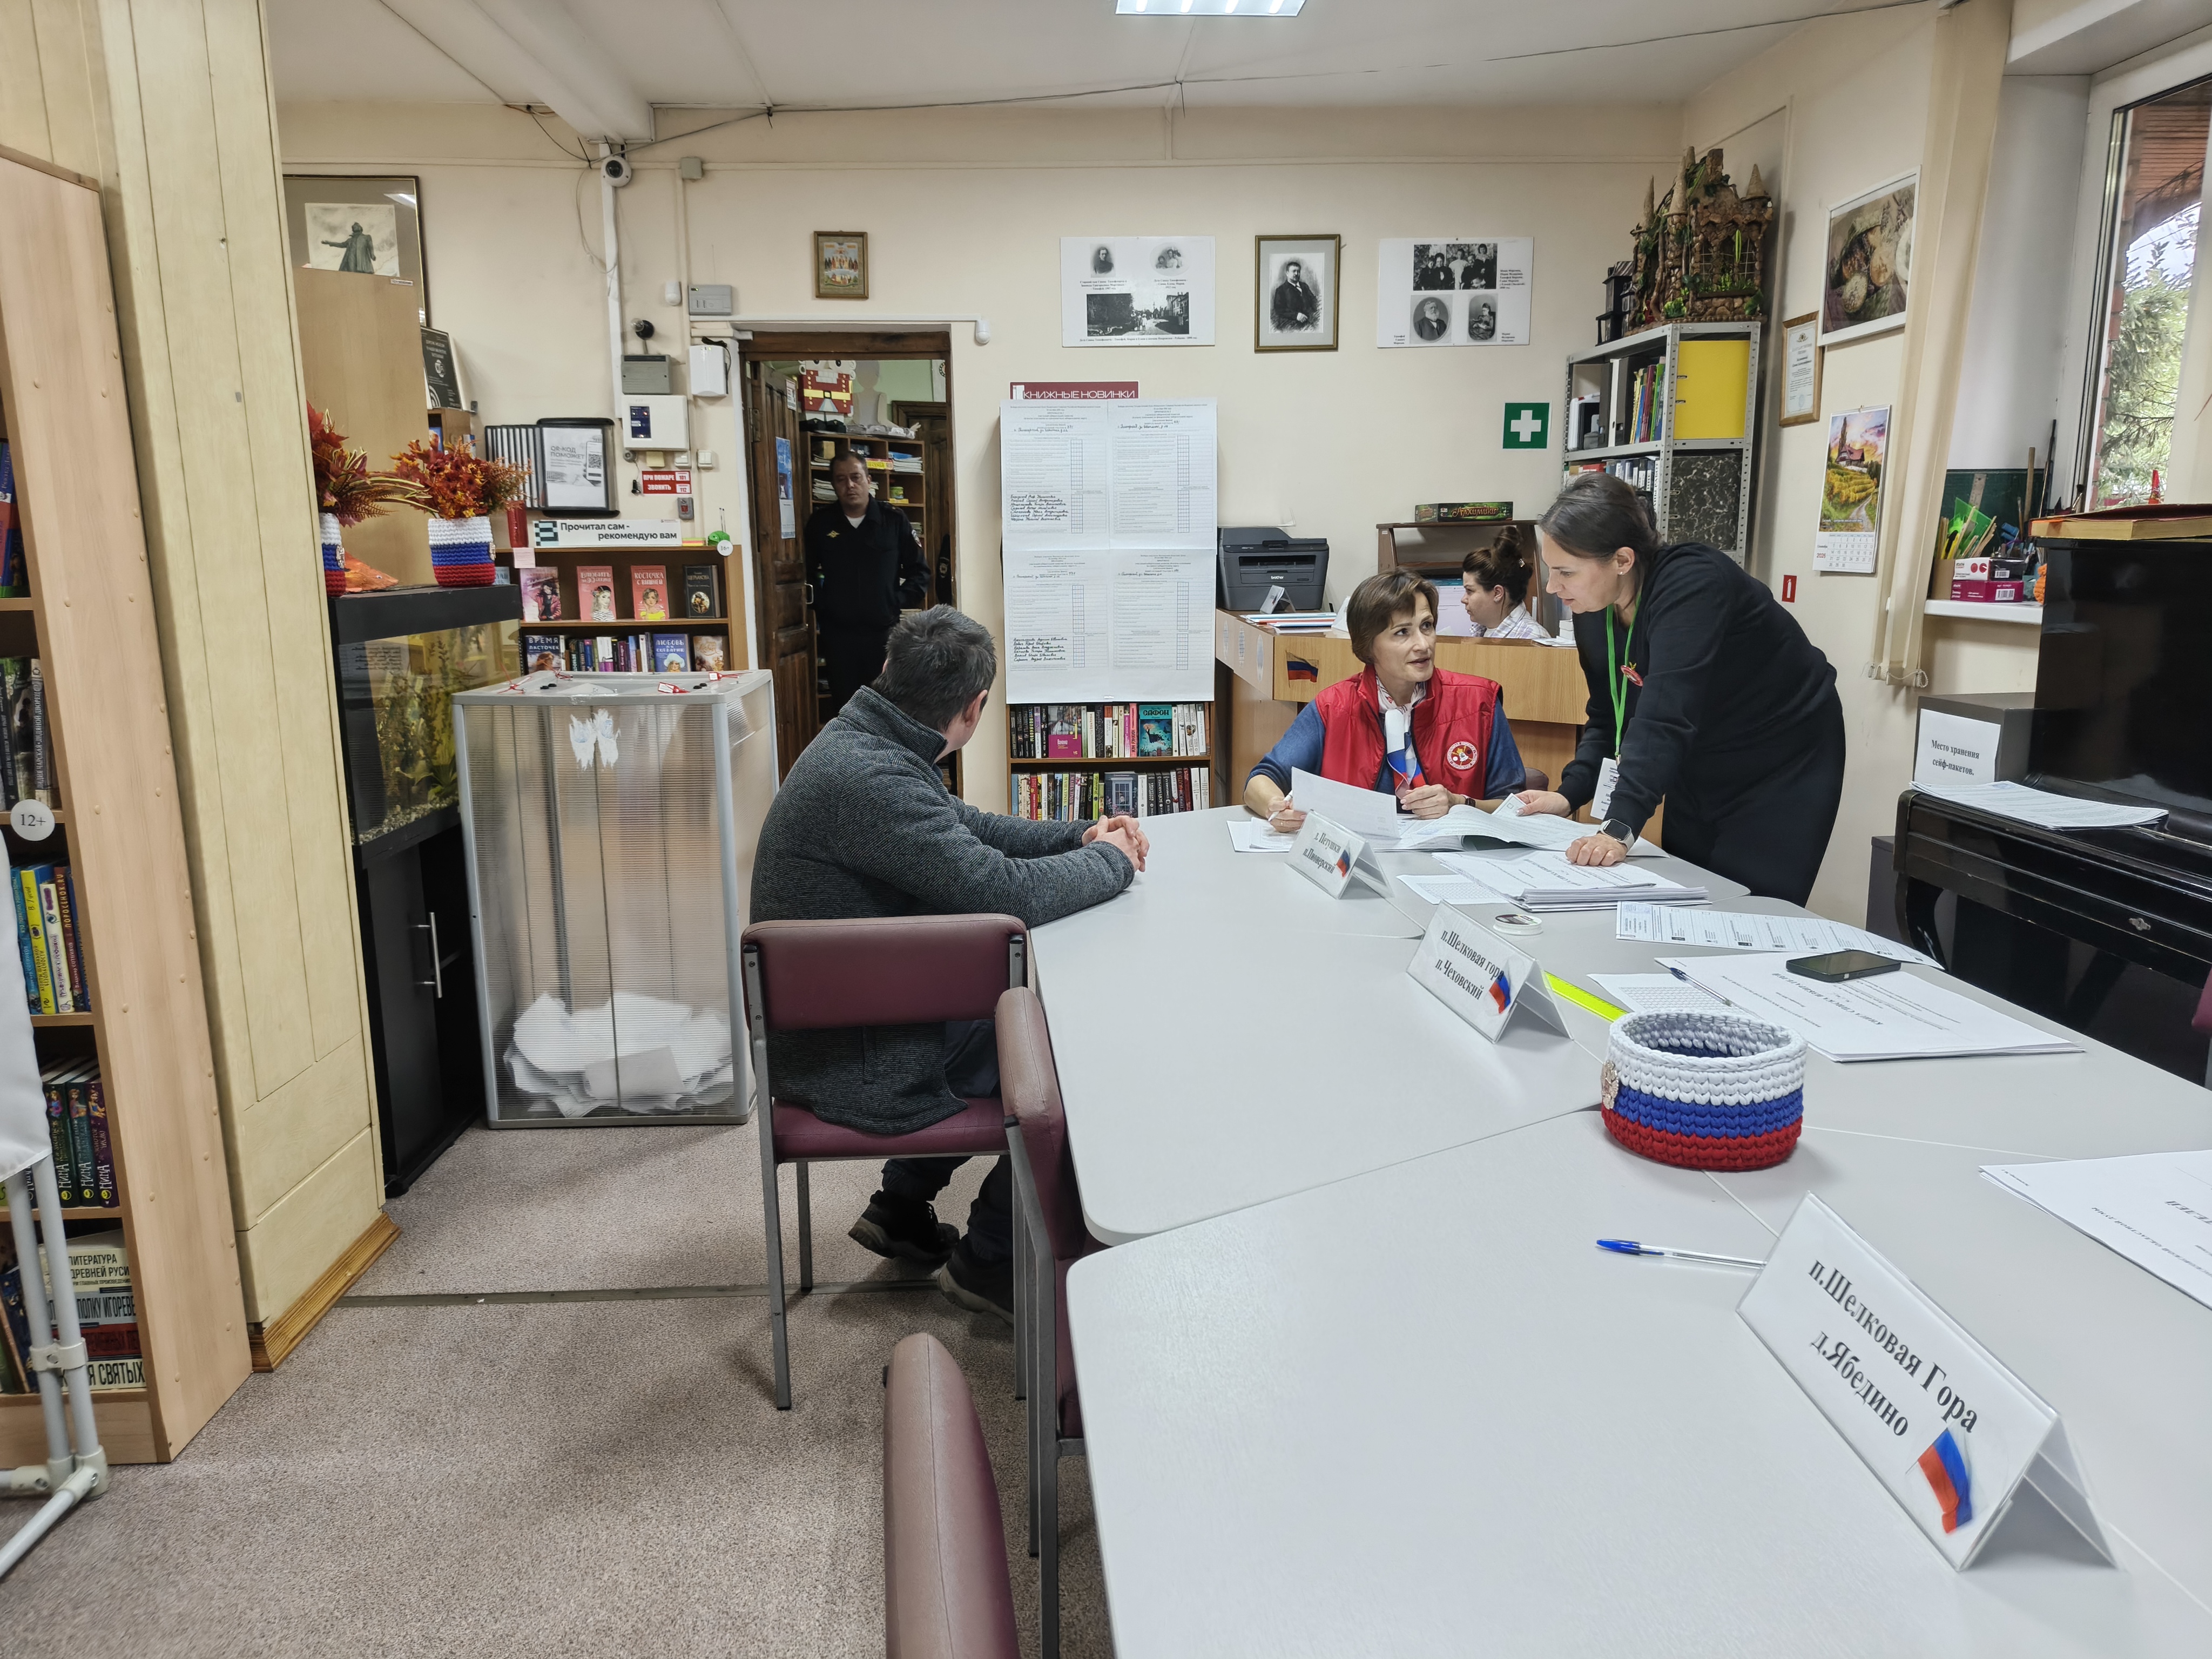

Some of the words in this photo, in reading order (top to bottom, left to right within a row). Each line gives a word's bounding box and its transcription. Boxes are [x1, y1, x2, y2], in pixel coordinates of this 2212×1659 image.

[1023, 390, 1079, 399] КНИЖНЫЕ
[1081, 390, 1135, 399] НОВИНКИ
[561, 523, 605, 532] Прочитал
[598, 532, 658, 541] рекомендую
[33, 691, 42, 714] ДВОРЕЦ
[35, 716, 43, 742] ЛЕДЯНОЙ
[35, 744, 43, 769] ЧАРСКАЯ
[1931, 739, 1950, 753] Место
[1950, 746, 1980, 760] хранения
[1932, 758, 1974, 777] сейф-пакетов.
[19, 814, 47, 827] 12+
[1318, 832, 1341, 853] Петушки
[56, 874, 72, 927] ПОРОСЕНОК.RU
[68, 941, 77, 967] СОТНИКОВ
[1440, 929, 1487, 967] п.Шелковая
[1444, 960, 1485, 1000] Чеховский
[56, 1164, 72, 1188] НИНА
[78, 1162, 94, 1186] НИНА
[97, 1164, 112, 1189] НИНА
[109, 1266, 130, 1278] РУСИ
[78, 1297, 101, 1319] ПОЛКУ
[104, 1296, 137, 1318] ИГОРЕВЕ
[1808, 1259, 1923, 1378] п.Шелковая
[1920, 1361, 1978, 1434] Гора
[98, 1361, 146, 1385] СВЯТЫХ
[1809, 1330, 1910, 1437] д.Ябедино
